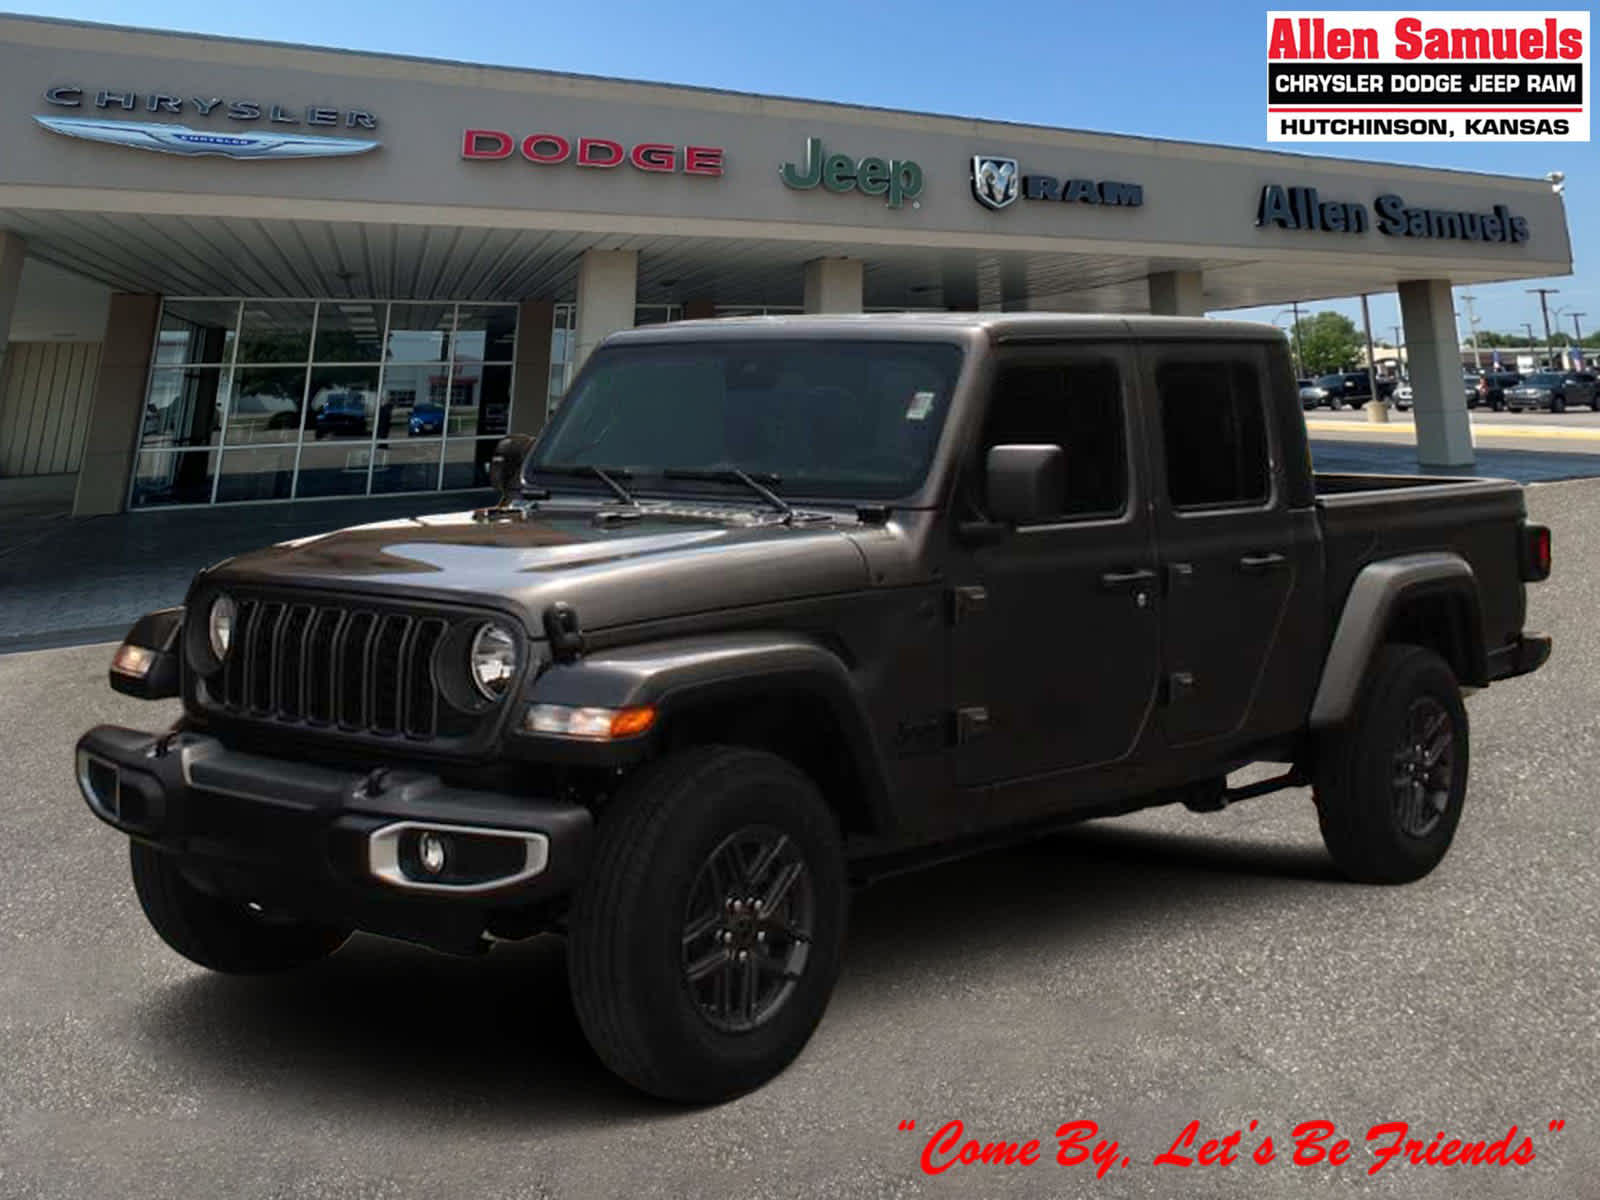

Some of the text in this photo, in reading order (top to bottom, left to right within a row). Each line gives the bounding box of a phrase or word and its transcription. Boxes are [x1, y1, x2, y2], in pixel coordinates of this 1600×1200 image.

[45, 86, 377, 129] CHRYSLER
[462, 128, 725, 176] DODGE
[780, 136, 924, 209] Jeep
[1023, 175, 1144, 207] RAM
[1256, 184, 1530, 244] Allen Samuels
